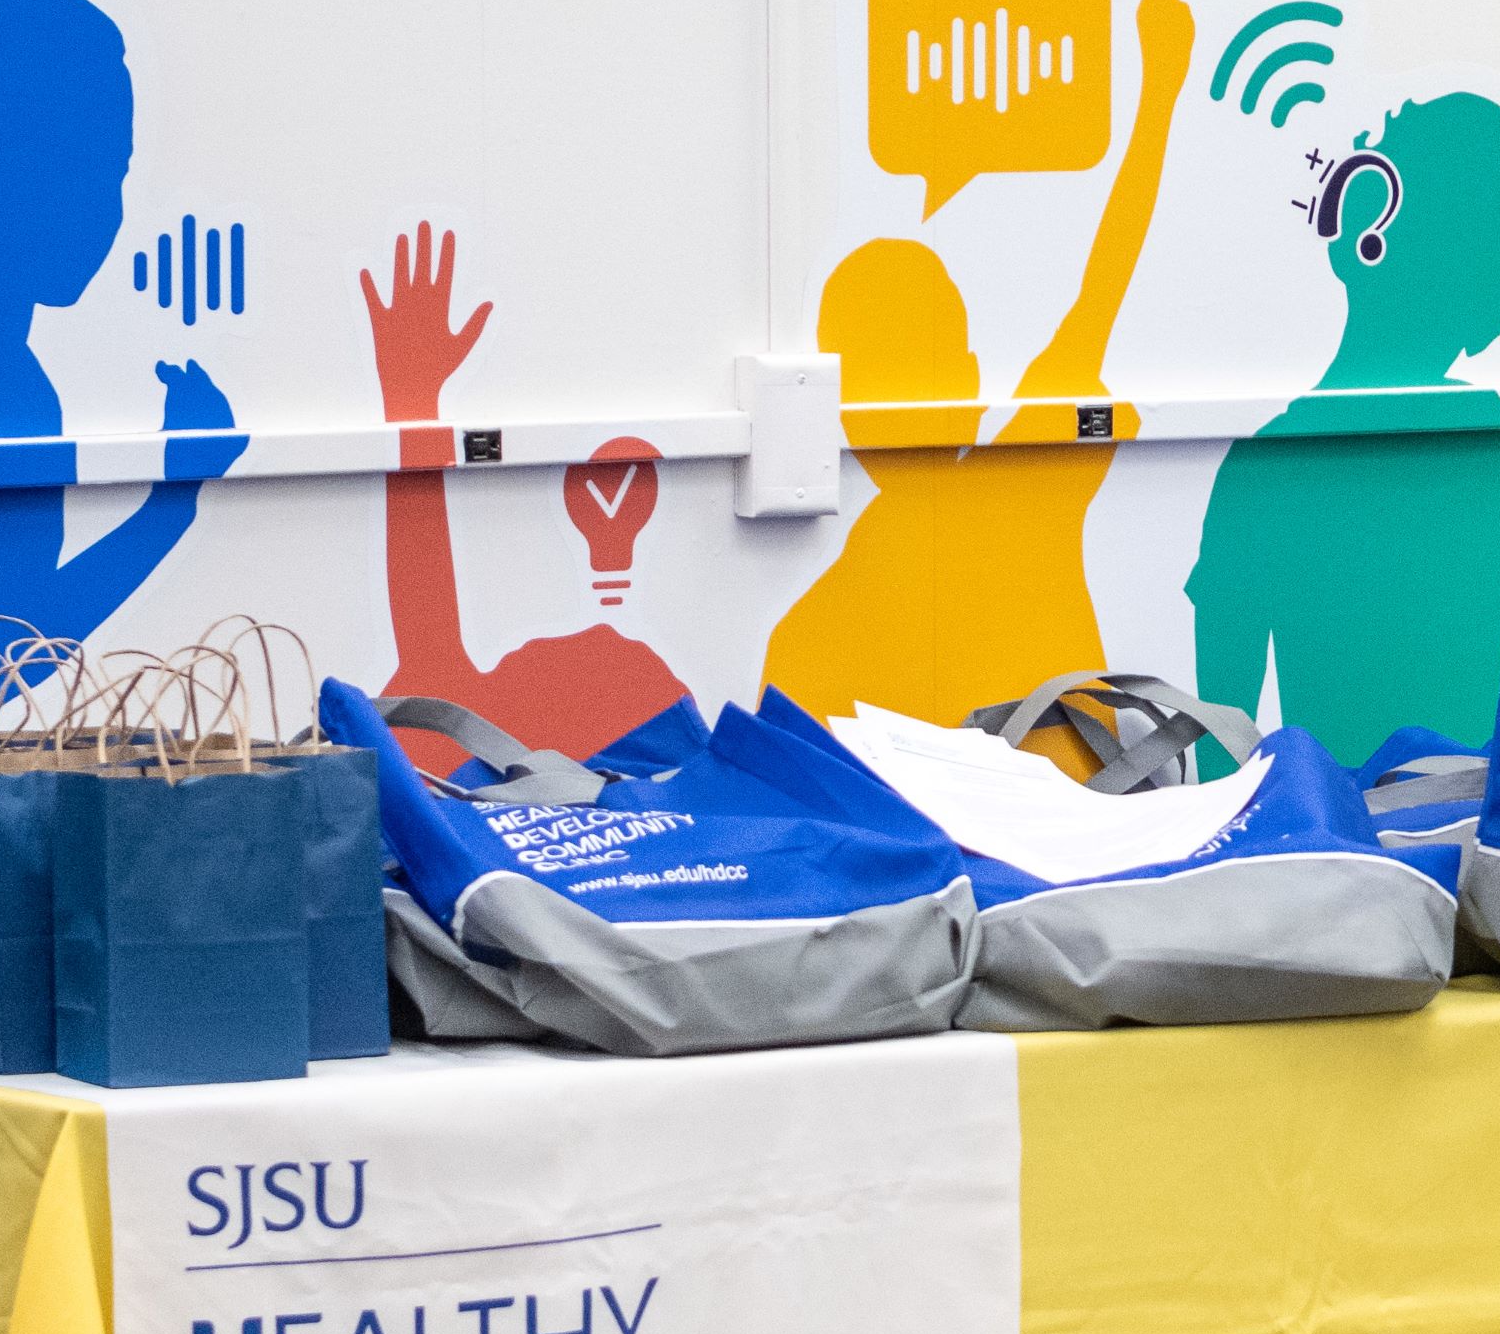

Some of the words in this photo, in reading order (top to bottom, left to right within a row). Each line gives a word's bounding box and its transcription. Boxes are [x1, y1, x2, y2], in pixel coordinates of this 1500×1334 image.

[517, 812, 695, 865] COMMUNITY
[568, 863, 749, 895] www.sjsu.edu/hdcc
[187, 1160, 368, 1249] SJSU
